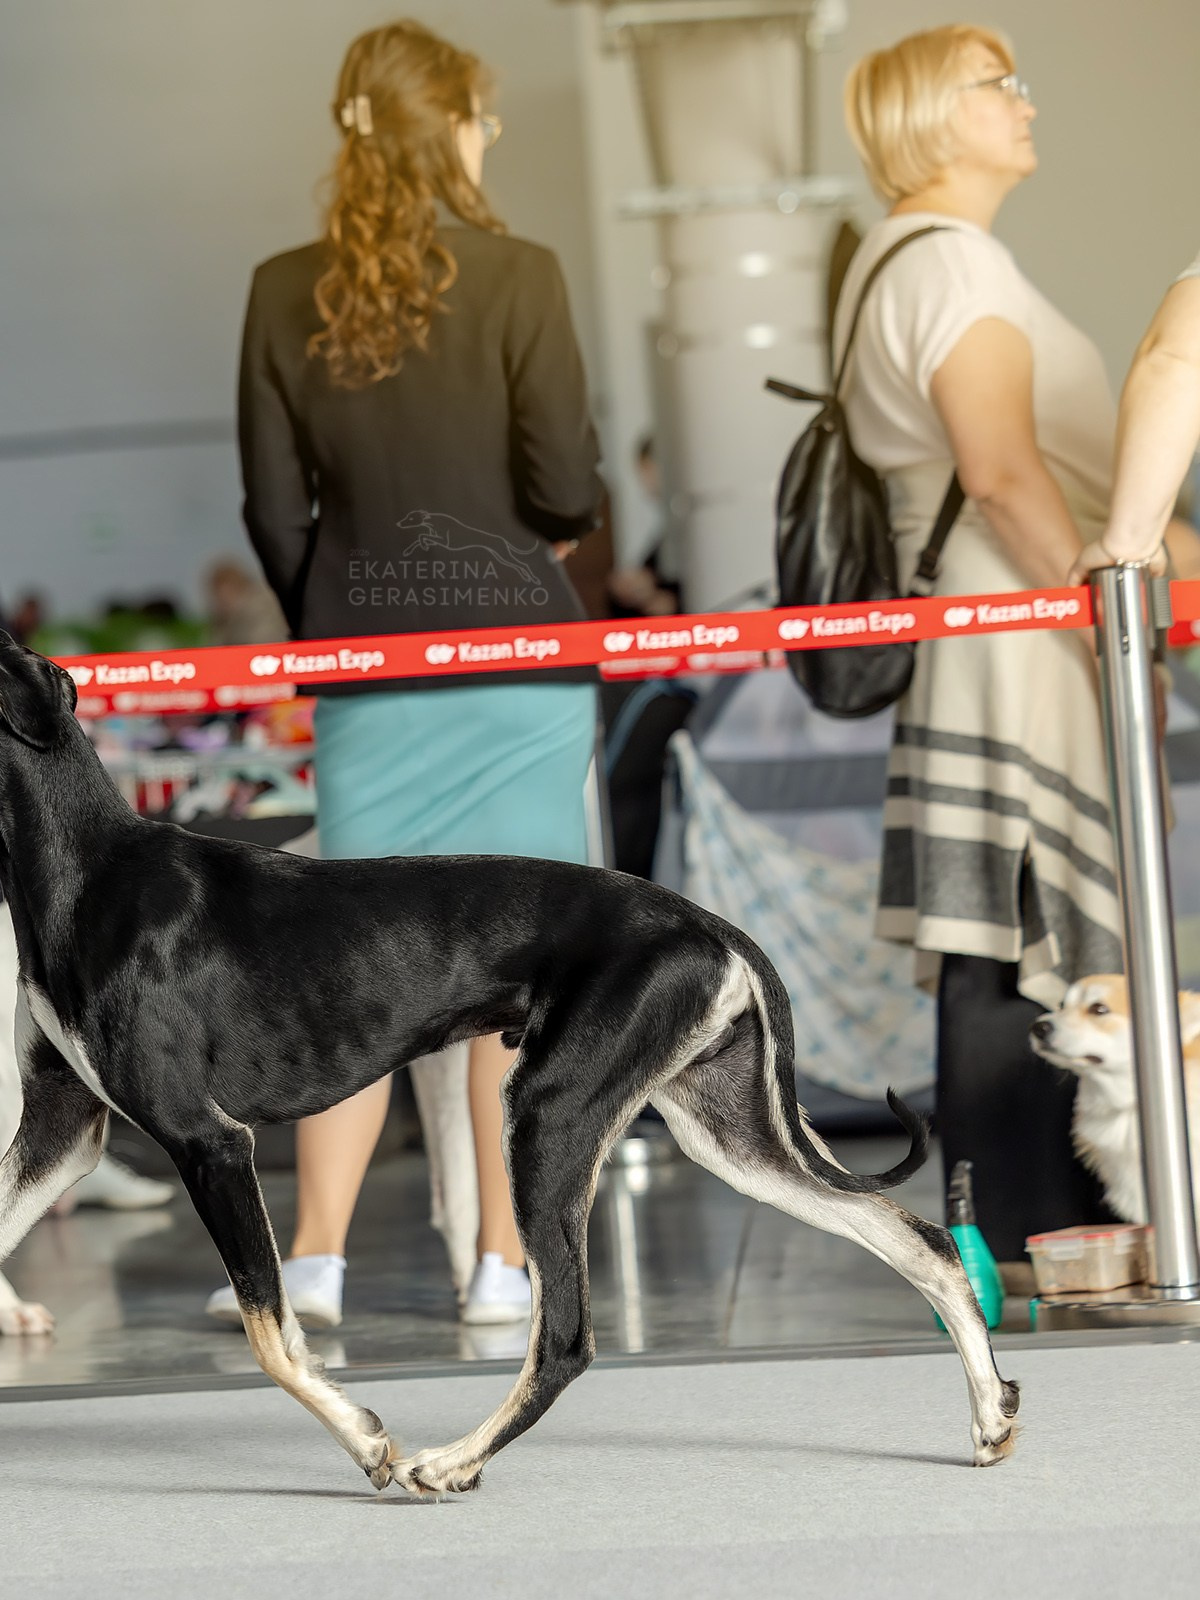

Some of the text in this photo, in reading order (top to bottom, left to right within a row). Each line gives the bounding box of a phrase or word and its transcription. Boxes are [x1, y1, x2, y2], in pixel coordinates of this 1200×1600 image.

[976, 597, 1080, 625] Kazan Expo
[636, 624, 739, 651] Kazan Expo
[811, 611, 916, 638] Kazan Expo
[282, 648, 385, 674] Kazan Expo
[457, 637, 561, 663] Kazan Expo
[95, 660, 196, 685] Kazan Expo
